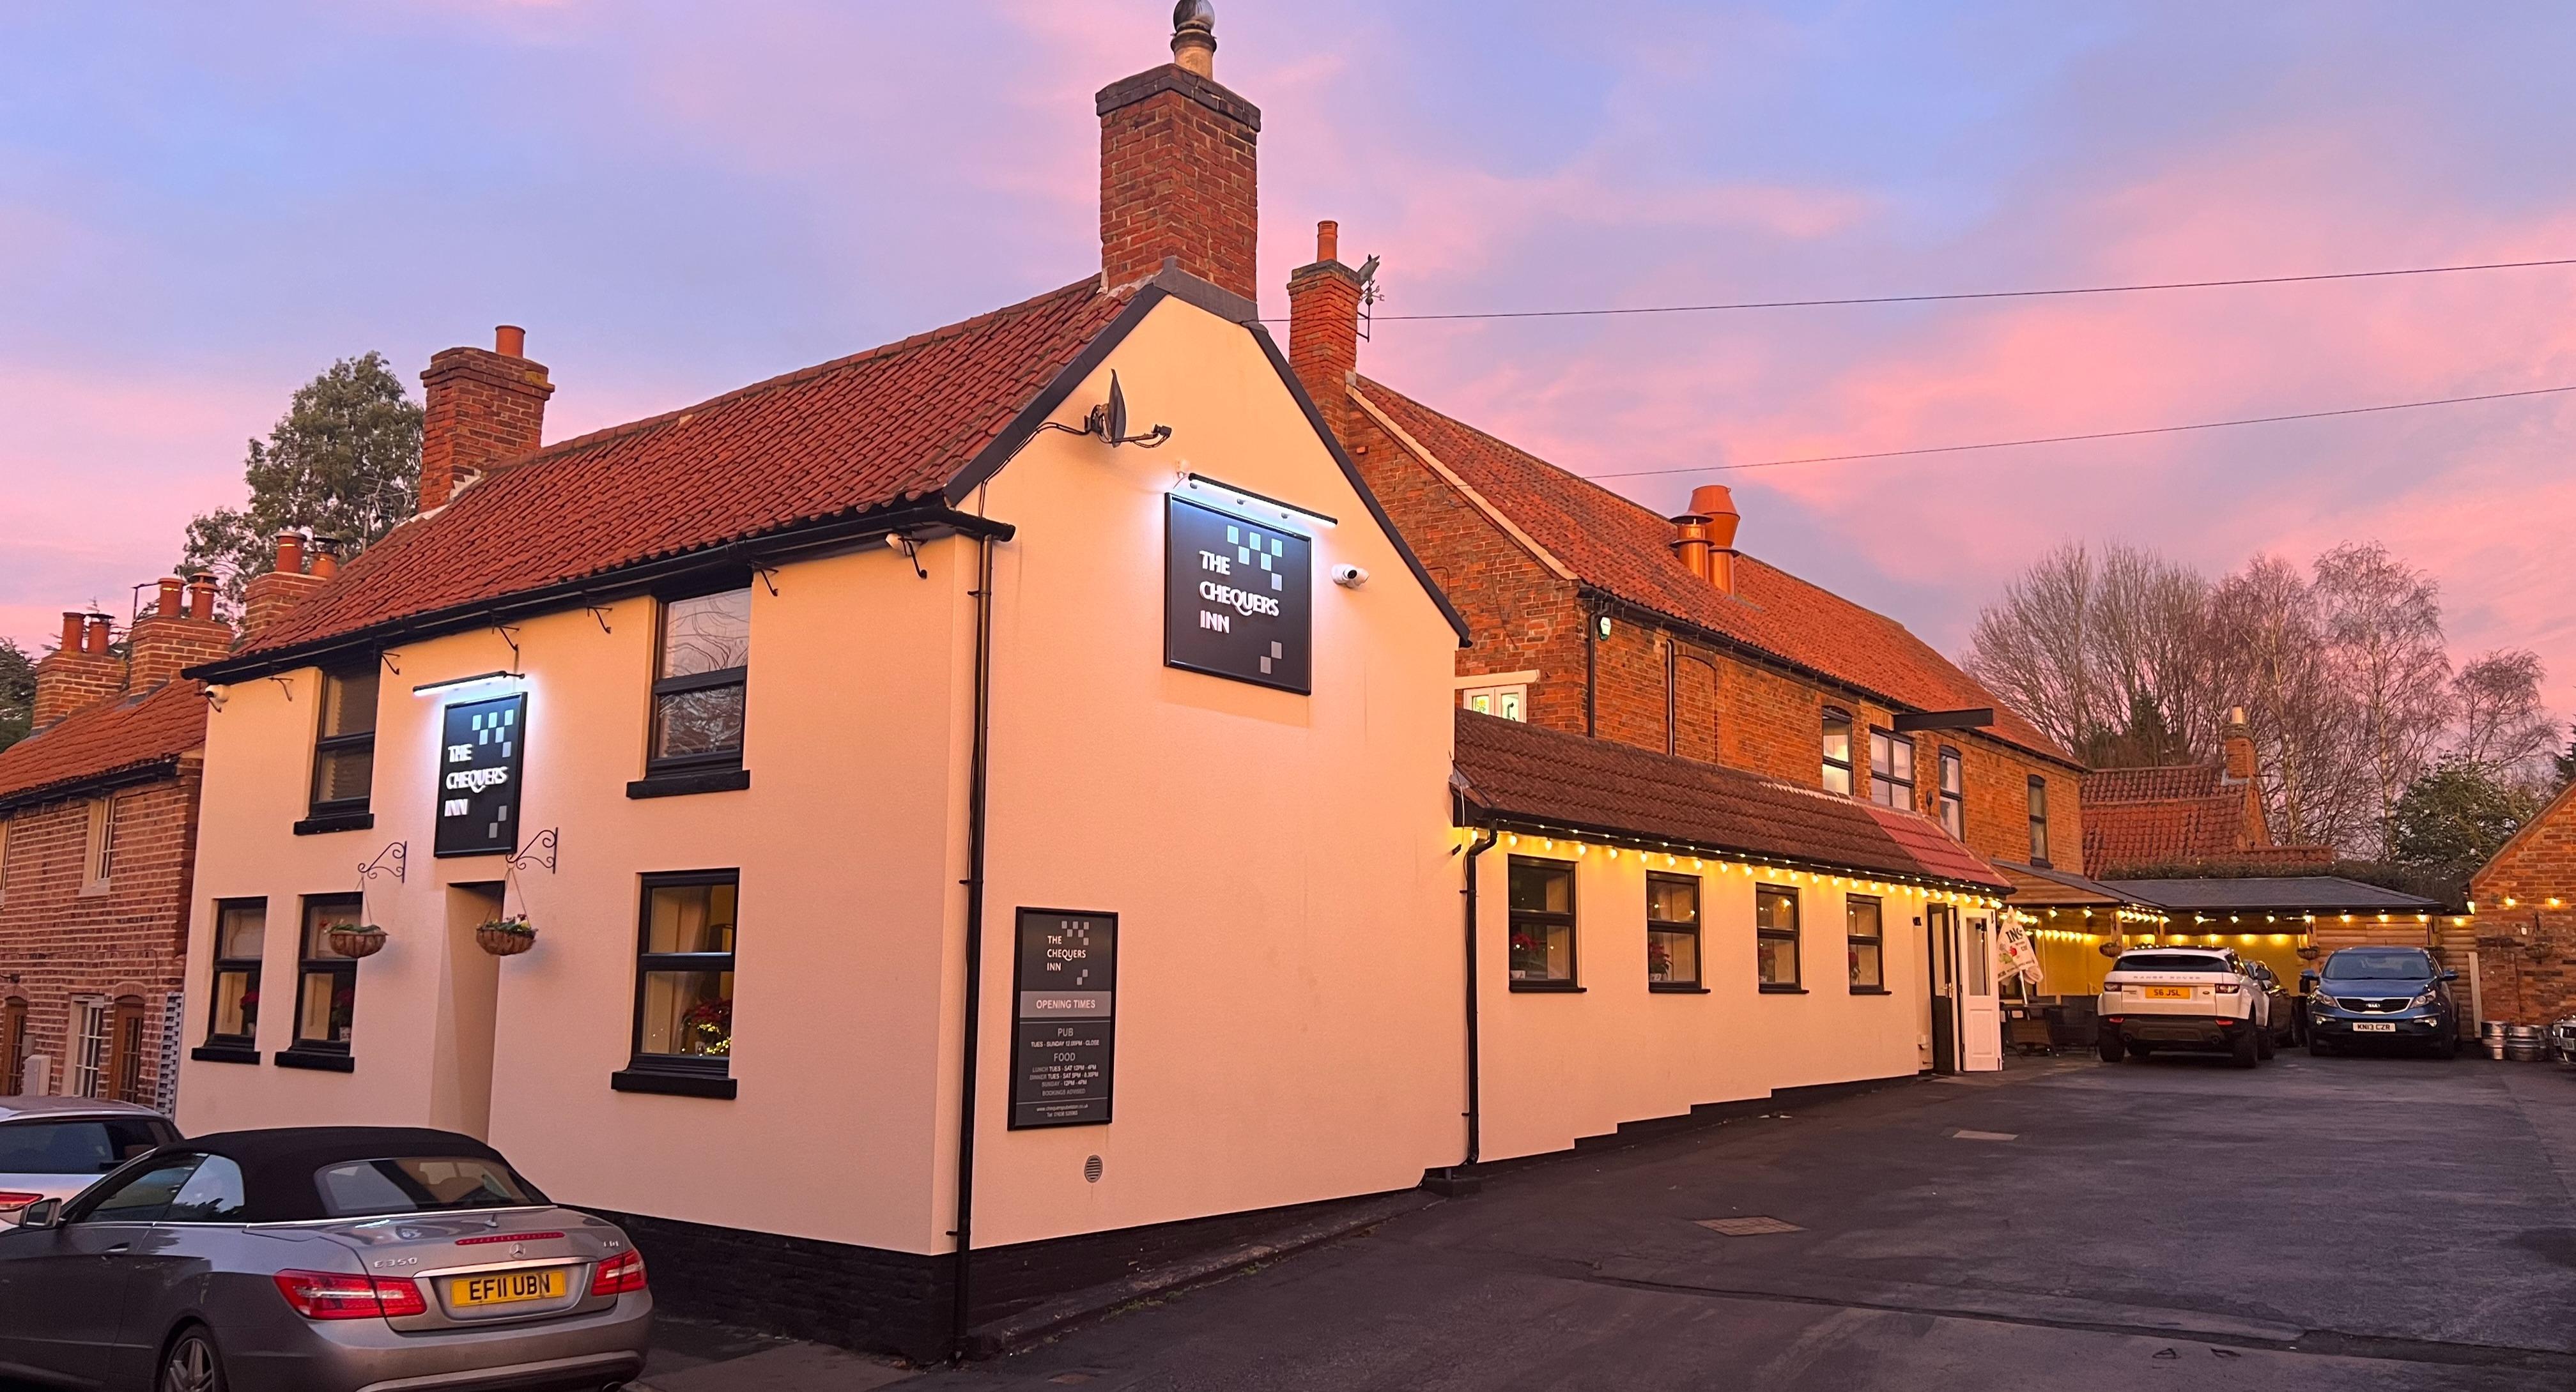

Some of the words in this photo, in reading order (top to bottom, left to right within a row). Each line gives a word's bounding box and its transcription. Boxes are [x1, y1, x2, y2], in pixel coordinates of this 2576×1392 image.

[1199, 550, 1231, 576] THE
[1199, 581, 1280, 617] CHEQUERS
[1199, 610, 1230, 634] INN
[447, 743, 474, 763] THE
[445, 766, 509, 794] CHEQUERS
[444, 798, 469, 817] INN
[1047, 935, 1062, 944] THE
[1047, 949, 1086, 961] CHEQUERS
[1047, 962, 1061, 971] INN
[1036, 999, 1072, 1009] OPENING
[1073, 999, 1096, 1009] TIMES
[1058, 1027, 1074, 1037] PUB
[1053, 1052, 1076, 1062] FOOD
[469, 1278, 509, 1301] EF11
[512, 1273, 551, 1296] UBN
